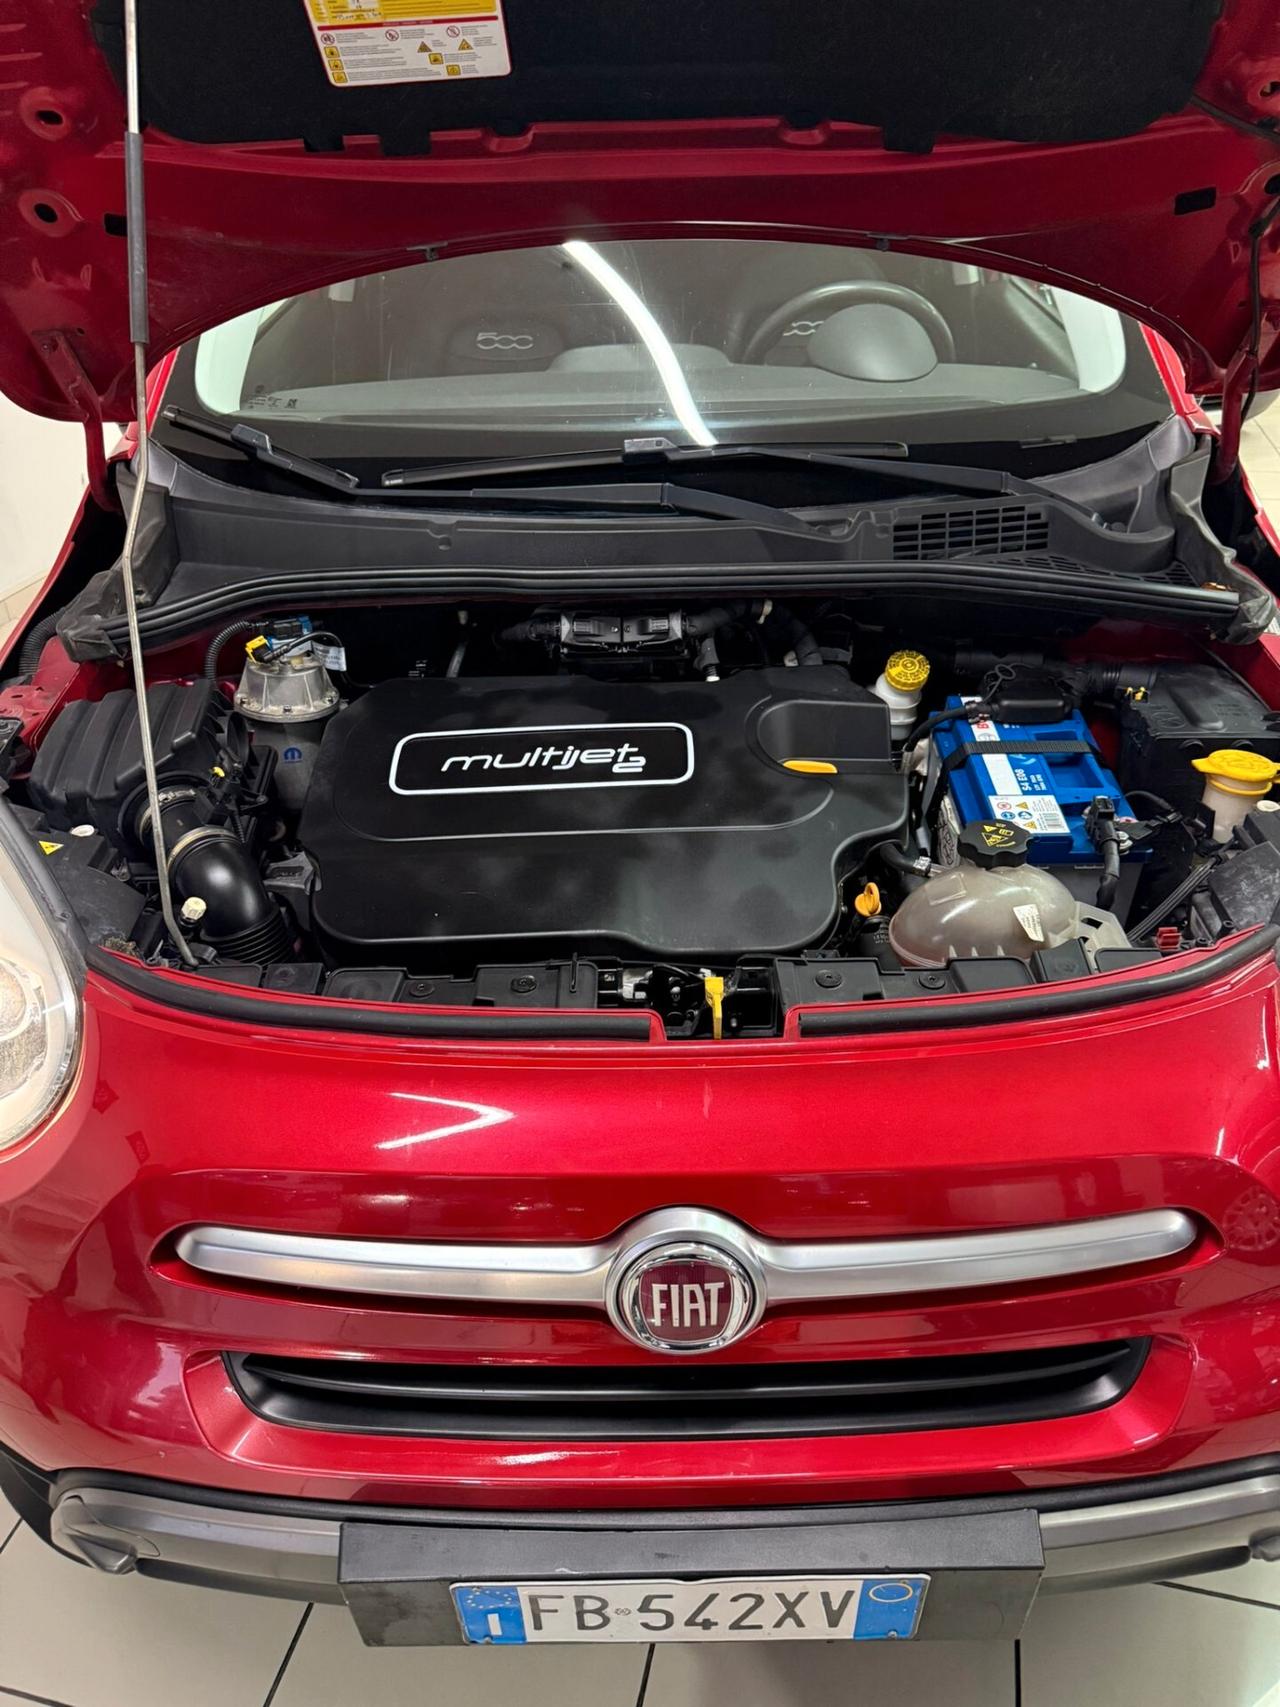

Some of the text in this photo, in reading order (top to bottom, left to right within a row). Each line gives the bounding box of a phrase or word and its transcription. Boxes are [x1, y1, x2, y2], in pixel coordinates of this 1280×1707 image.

[476, 331, 534, 350] 500
[651, 1281, 725, 1328] FIAT
[527, 1594, 611, 1631] FB
[638, 1589, 856, 1632] 542XV
